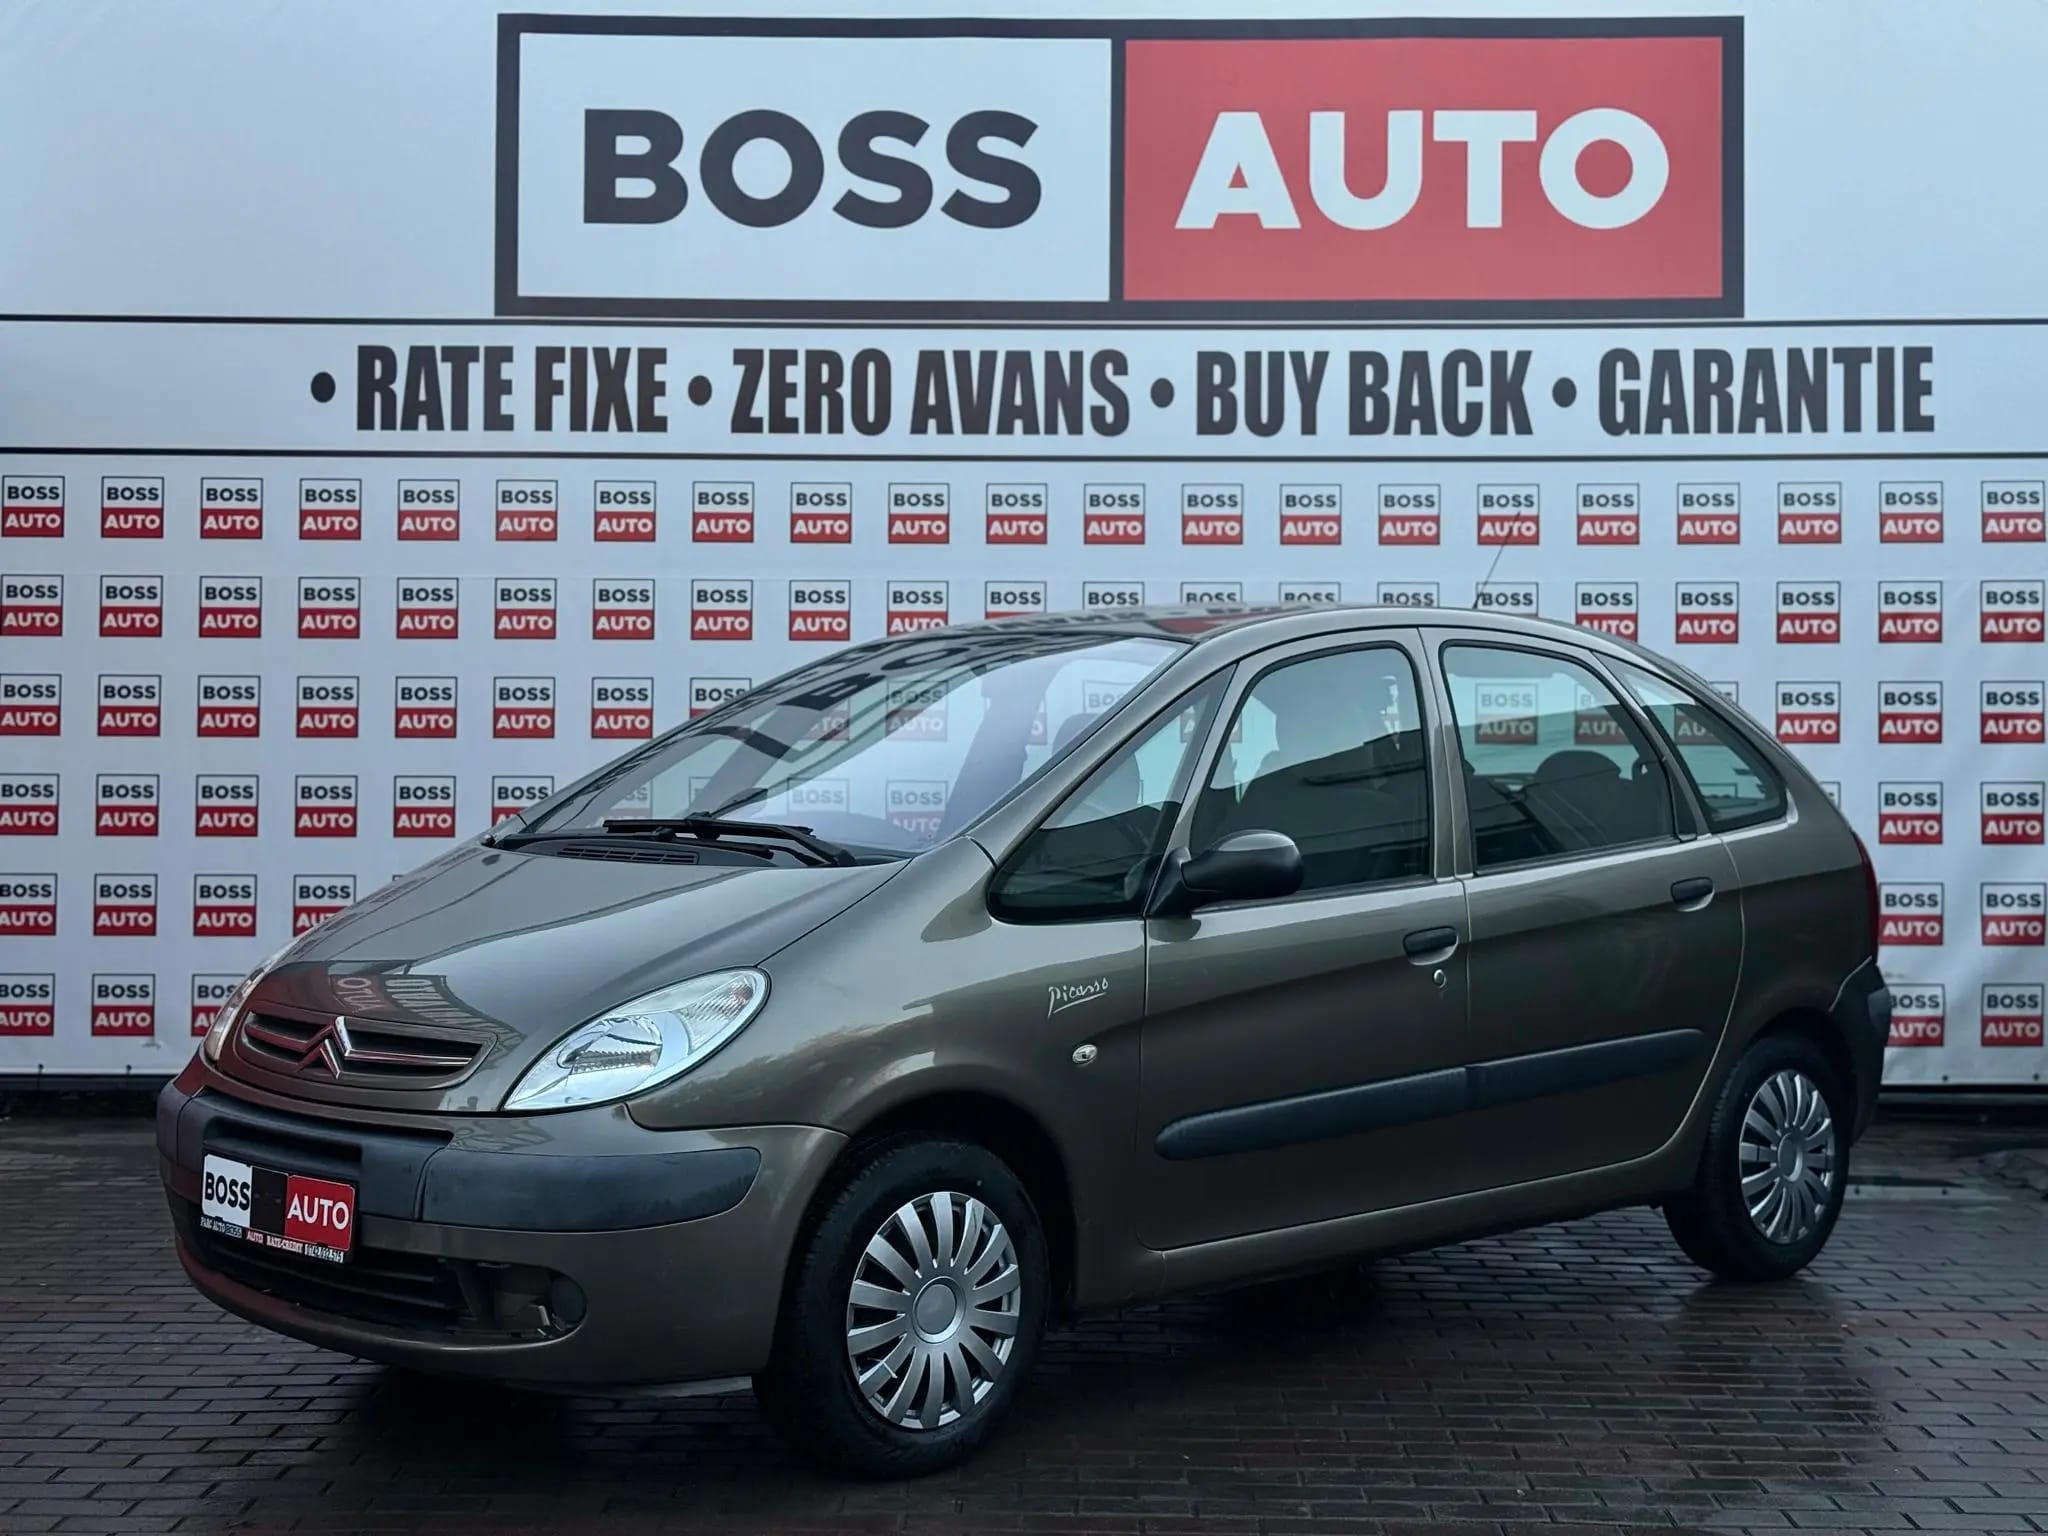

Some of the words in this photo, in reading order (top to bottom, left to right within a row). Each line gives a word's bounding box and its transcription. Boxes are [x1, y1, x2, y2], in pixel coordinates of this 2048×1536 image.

[584, 109, 1041, 228] BOSS
[1176, 108, 1669, 230] AUTO
[357, 345, 514, 431] RATE
[535, 346, 667, 432] FIXE
[731, 348, 891, 436] ZERO
[910, 349, 1129, 437] AVANS
[1197, 351, 1329, 437] BUY
[1349, 349, 1533, 437] BACK
[1599, 347, 1934, 436] GARANTIE
[7, 485, 59, 500] BOSS
[106, 486, 159, 501] BOSS
[206, 487, 258, 502] BOSS
[304, 488, 357, 503] BOSS
[403, 489, 455, 504] BOSS
[501, 489, 553, 504] BOSS
[599, 490, 652, 505] BOSS
[697, 491, 750, 506] BOSS
[795, 492, 847, 507] BOSS
[893, 493, 945, 507] BOSS
[1682, 493, 1735, 507] BOSS
[1783, 492, 1837, 507] BOSS
[1885, 491, 1938, 506] BOSS
[1988, 490, 2041, 505] BOSS
[991, 493, 1043, 508] BOSS
[1089, 493, 1141, 508] BOSS
[1187, 494, 1239, 508] BOSS
[1285, 494, 1337, 508] BOSS
[1383, 494, 1436, 508] BOSS
[1483, 494, 1535, 508] BOSS
[1582, 493, 1635, 508] BOSS
[5, 513, 60, 528] AUTO
[104, 514, 160, 529] AUTO
[204, 515, 260, 530] AUTO
[303, 516, 359, 531] AUTO
[402, 516, 457, 532] AUTO
[500, 517, 555, 532] AUTO
[598, 518, 653, 533] AUTO
[696, 518, 751, 534] AUTO
[794, 519, 849, 535] AUTO
[892, 520, 947, 535] AUTO
[989, 520, 1045, 536] AUTO
[1087, 520, 1143, 536] AUTO
[1681, 520, 1737, 536] AUTO
[1782, 519, 1838, 535] AUTO
[1884, 518, 1940, 535] AUTO
[1987, 518, 2043, 534] AUTO
[1185, 521, 1241, 536] AUTO
[1284, 521, 1339, 537] AUTO
[1382, 521, 1438, 537] AUTO
[1482, 521, 1537, 537] AUTO
[1581, 521, 1637, 537] AUTO
[5, 584, 57, 599] BOSS
[105, 585, 157, 600] BOSS
[204, 586, 257, 601] BOSS
[303, 587, 356, 602] BOSS
[402, 587, 454, 602] BOSS
[500, 588, 552, 602] BOSS
[598, 588, 650, 603] BOSS
[696, 589, 748, 604] BOSS
[794, 589, 846, 604] BOSS
[892, 590, 944, 605] BOSS
[990, 591, 1042, 605] BOSS
[1088, 591, 1140, 606] BOSS
[1682, 592, 1734, 606] BOSS
[1783, 591, 1836, 606] BOSS
[1884, 591, 1937, 606] BOSS
[1987, 590, 2040, 605] BOSS
[1382, 592, 1435, 607] BOSS
[1482, 592, 1534, 607] BOSS
[1581, 592, 1633, 607] BOSS
[3, 612, 58, 627] AUTO
[103, 613, 158, 628] AUTO
[202, 614, 258, 629] AUTO
[301, 614, 357, 630] AUTO
[400, 615, 455, 630] AUTO
[498, 615, 553, 630] AUTO
[596, 615, 652, 631] AUTO
[694, 616, 750, 632] AUTO
[792, 617, 847, 632] AUTO
[890, 618, 946, 634] AUTO
[1681, 619, 1736, 635] AUTO
[1782, 619, 1838, 635] AUTO
[1883, 618, 1939, 634] AUTO
[1986, 618, 2042, 634] AUTO
[3, 684, 55, 699] BOSS
[103, 684, 155, 700] BOSS
[203, 685, 255, 700] BOSS
[302, 686, 354, 701] BOSS
[400, 686, 453, 701] BOSS
[498, 687, 551, 701] BOSS
[597, 687, 649, 702] BOSS
[1782, 691, 1836, 706] BOSS
[1884, 691, 1938, 706] BOSS
[1987, 691, 2040, 706] BOSS
[1481, 693, 1534, 706] BOSS
[0, 711, 56, 727] AUTO
[101, 712, 156, 728] AUTO
[200, 713, 256, 728] AUTO
[299, 713, 355, 729] AUTO
[398, 714, 454, 729] AUTO
[497, 714, 552, 730] AUTO
[595, 714, 650, 730] AUTO
[1986, 718, 2042, 735] AUTO
[1478, 719, 1535, 736] AUTO
[1781, 719, 1837, 735] AUTO
[1883, 719, 1939, 735] AUTO
[1, 783, 53, 798] BOSS
[101, 784, 154, 799] BOSS
[201, 785, 254, 800] BOSS
[300, 785, 353, 800] BOSS
[399, 786, 451, 800] BOSS
[497, 786, 549, 800] BOSS
[890, 791, 943, 804] BOSS
[1884, 792, 1938, 807] BOSS
[1987, 792, 2040, 807] BOSS
[0, 812, 54, 827] AUTO
[99, 812, 155, 827] AUTO
[199, 812, 255, 828] AUTO
[298, 813, 354, 828] AUTO
[397, 813, 452, 829] AUTO
[1883, 820, 1939, 836] AUTO
[1986, 820, 2042, 836] AUTO
[0, 884, 52, 898] BOSS
[99, 884, 152, 899] BOSS
[199, 884, 252, 899] BOSS
[298, 885, 351, 900] BOSS
[1884, 893, 1938, 908] BOSS
[1986, 893, 2040, 908] BOSS
[0, 911, 53, 926] AUTO
[97, 911, 153, 927] AUTO
[197, 912, 253, 928] AUTO
[1883, 921, 1939, 937] AUTO
[1985, 920, 2041, 937] AUTO
[97, 984, 150, 999] BOSS
[1047, 977, 1109, 1018] Picasso
[1987, 994, 2039, 1009] BOSS
[96, 1012, 151, 1027] AUTO
[1986, 1022, 2041, 1038] AUTO
[204, 1171, 251, 1211] BOSS
[287, 1193, 350, 1230] AUTO
[246, 1230, 264, 1244] AUTO
